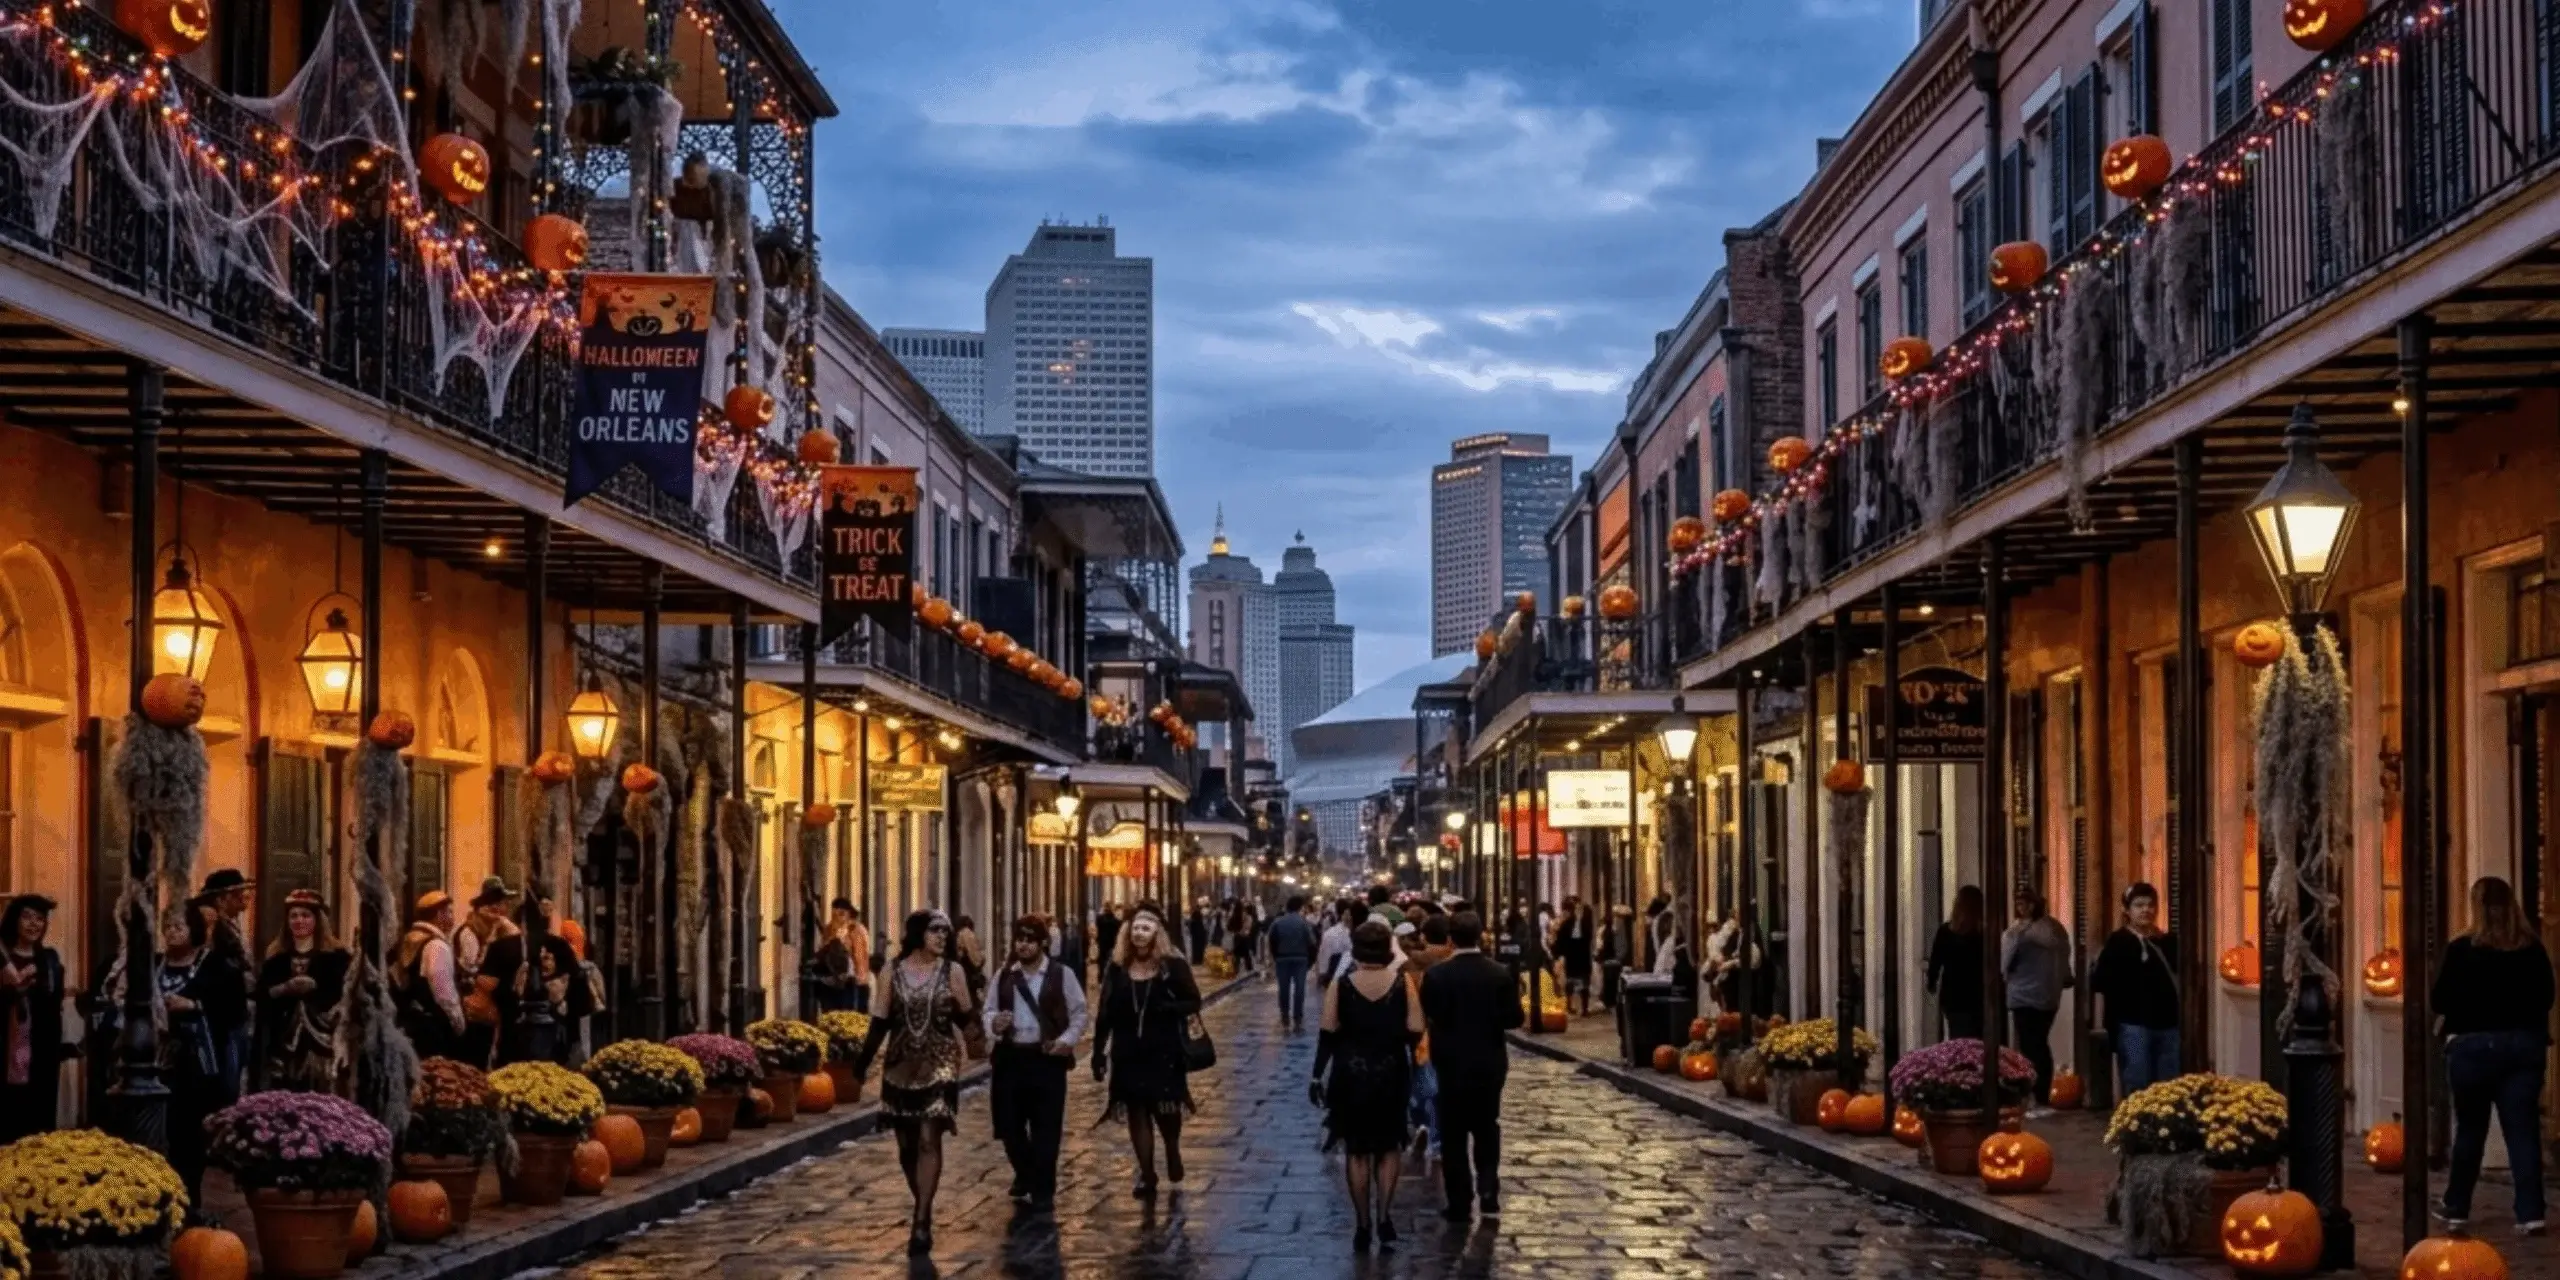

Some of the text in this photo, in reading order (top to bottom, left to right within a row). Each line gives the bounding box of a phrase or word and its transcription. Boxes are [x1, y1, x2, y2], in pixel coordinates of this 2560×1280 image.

[584, 345, 699, 368] HALLOWEEN
[609, 387, 666, 413] NEW
[579, 416, 690, 444] ORLEANS
[832, 527, 904, 555] TRICK
[829, 574, 905, 601] TREAT
